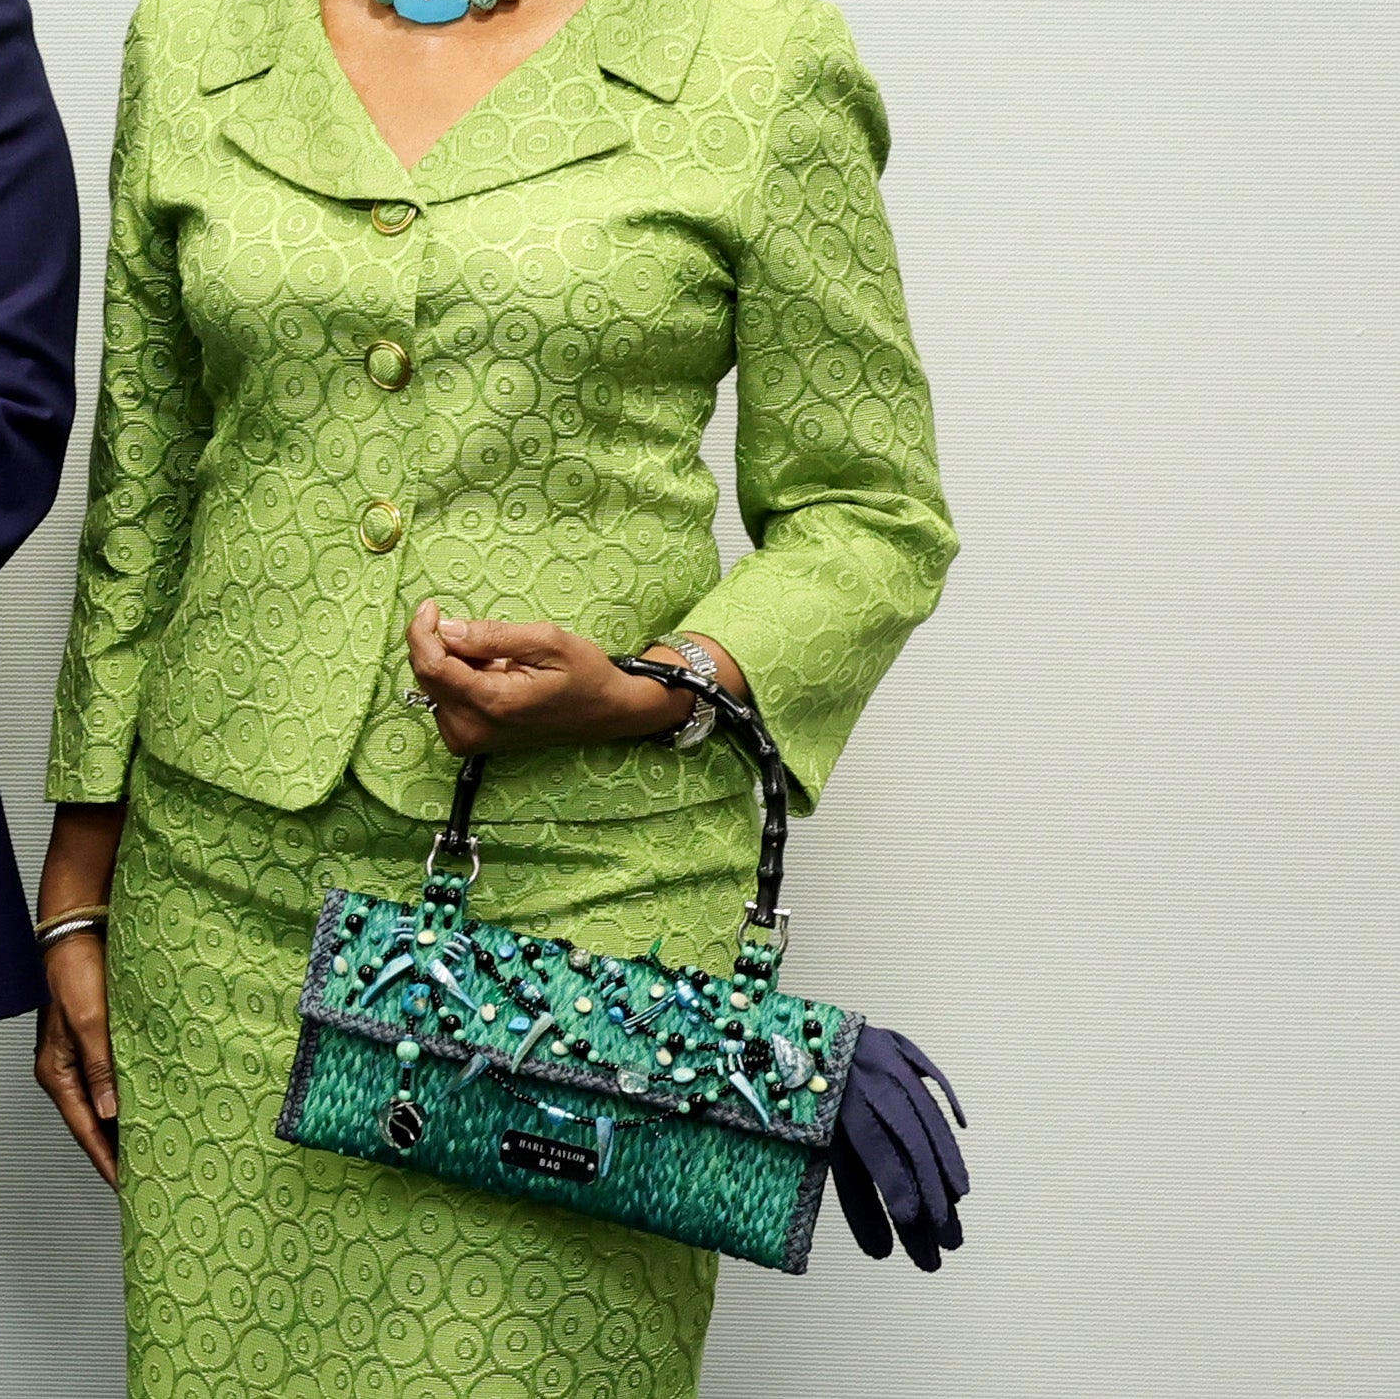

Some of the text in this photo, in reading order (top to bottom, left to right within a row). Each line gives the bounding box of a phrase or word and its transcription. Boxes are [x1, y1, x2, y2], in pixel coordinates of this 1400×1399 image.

[518, 1139, 586, 1163] HARL TAYLOR
[538, 1157, 561, 1171] BAG
